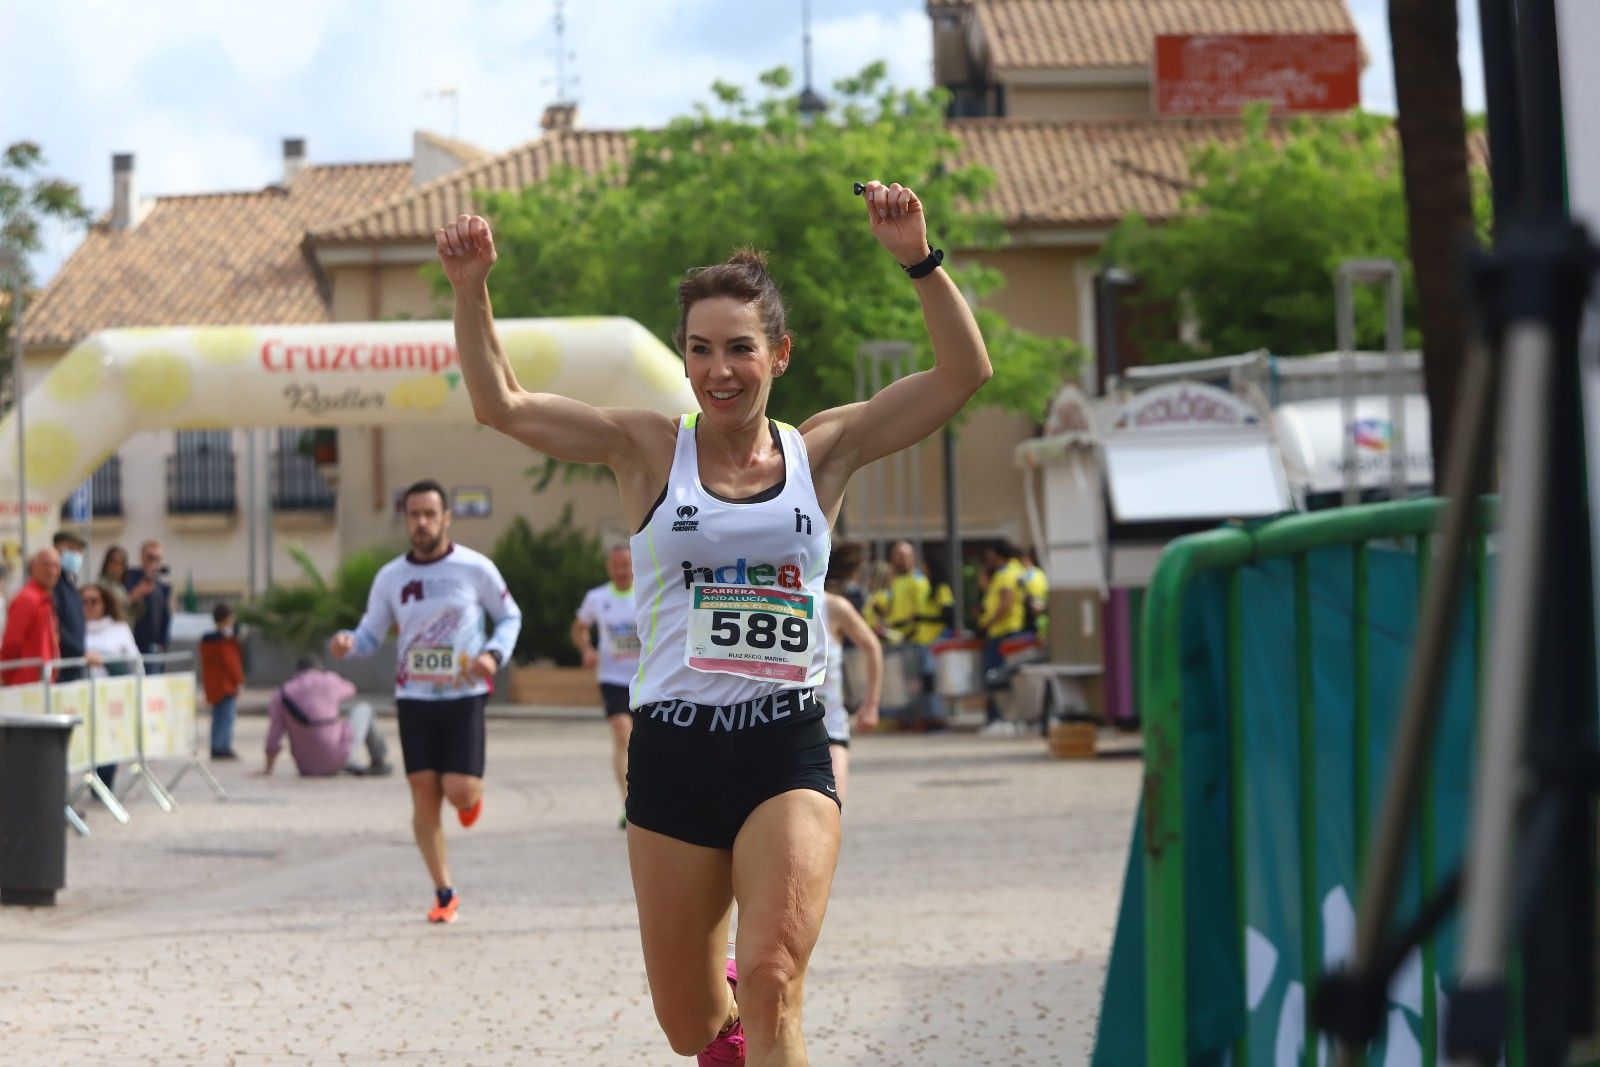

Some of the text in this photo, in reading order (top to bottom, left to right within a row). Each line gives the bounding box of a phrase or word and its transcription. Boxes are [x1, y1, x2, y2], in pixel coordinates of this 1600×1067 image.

[282, 382, 386, 417] Radler
[681, 558, 802, 589] indea
[702, 595, 769, 603] ANDALUCÍA
[703, 601, 751, 609] CONTRA
[767, 604, 794, 614] ODIO
[710, 611, 809, 653] 589
[413, 654, 453, 670] 208
[764, 655, 790, 663] MARIBEL
[709, 690, 791, 732] NIKE
